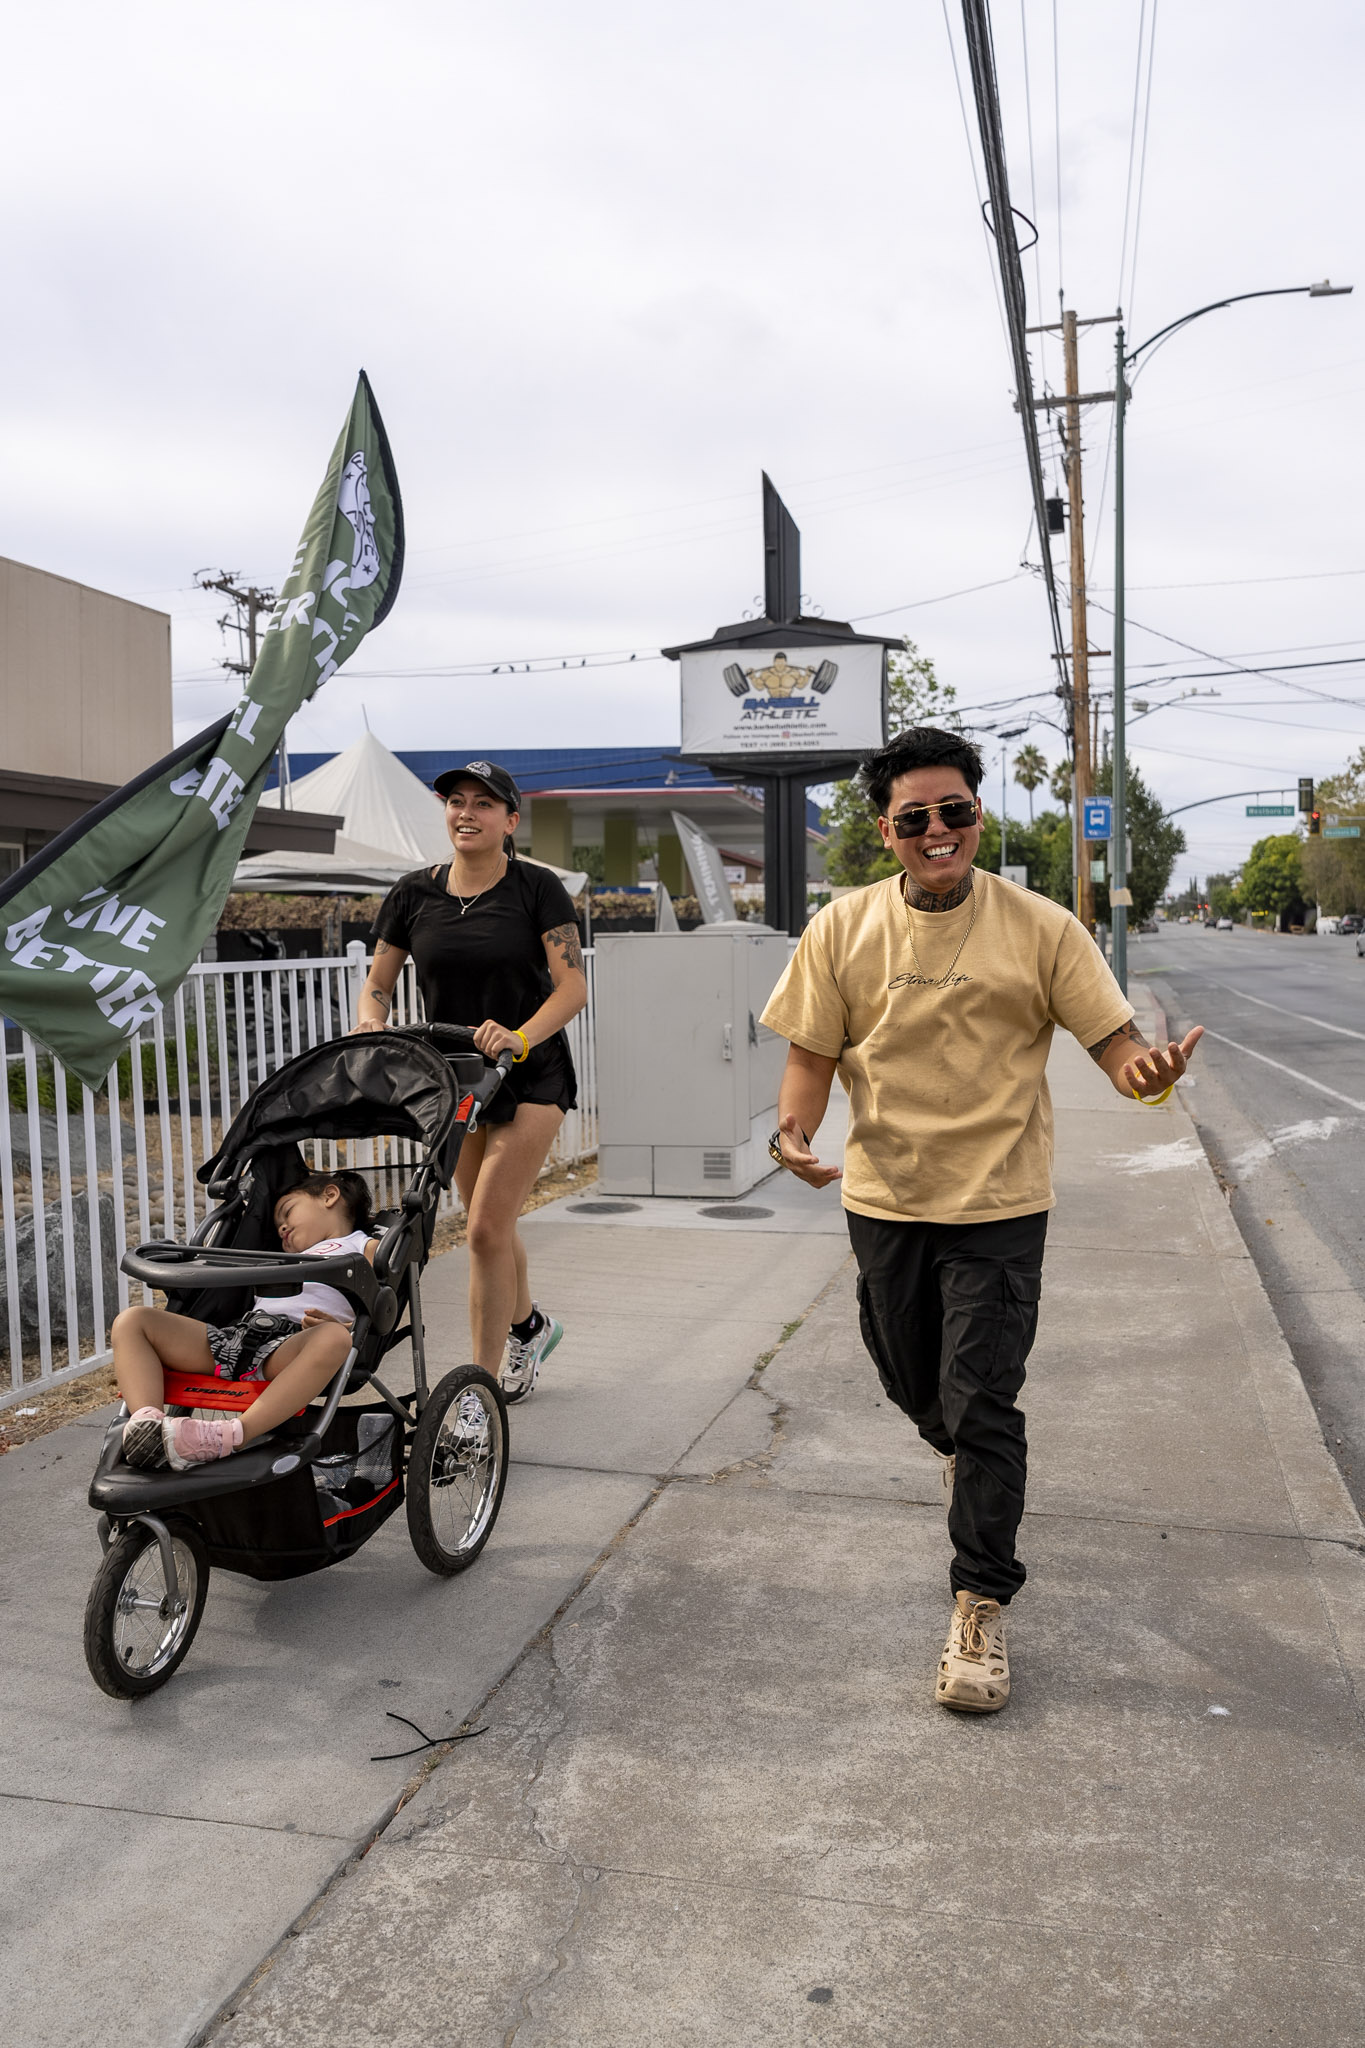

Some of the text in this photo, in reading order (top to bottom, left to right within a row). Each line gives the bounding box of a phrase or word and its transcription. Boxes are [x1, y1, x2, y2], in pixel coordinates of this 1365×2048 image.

[740, 708, 819, 722] ATHLETIC
[4, 904, 165, 1038] BETTER
[937, 971, 974, 991] Life
